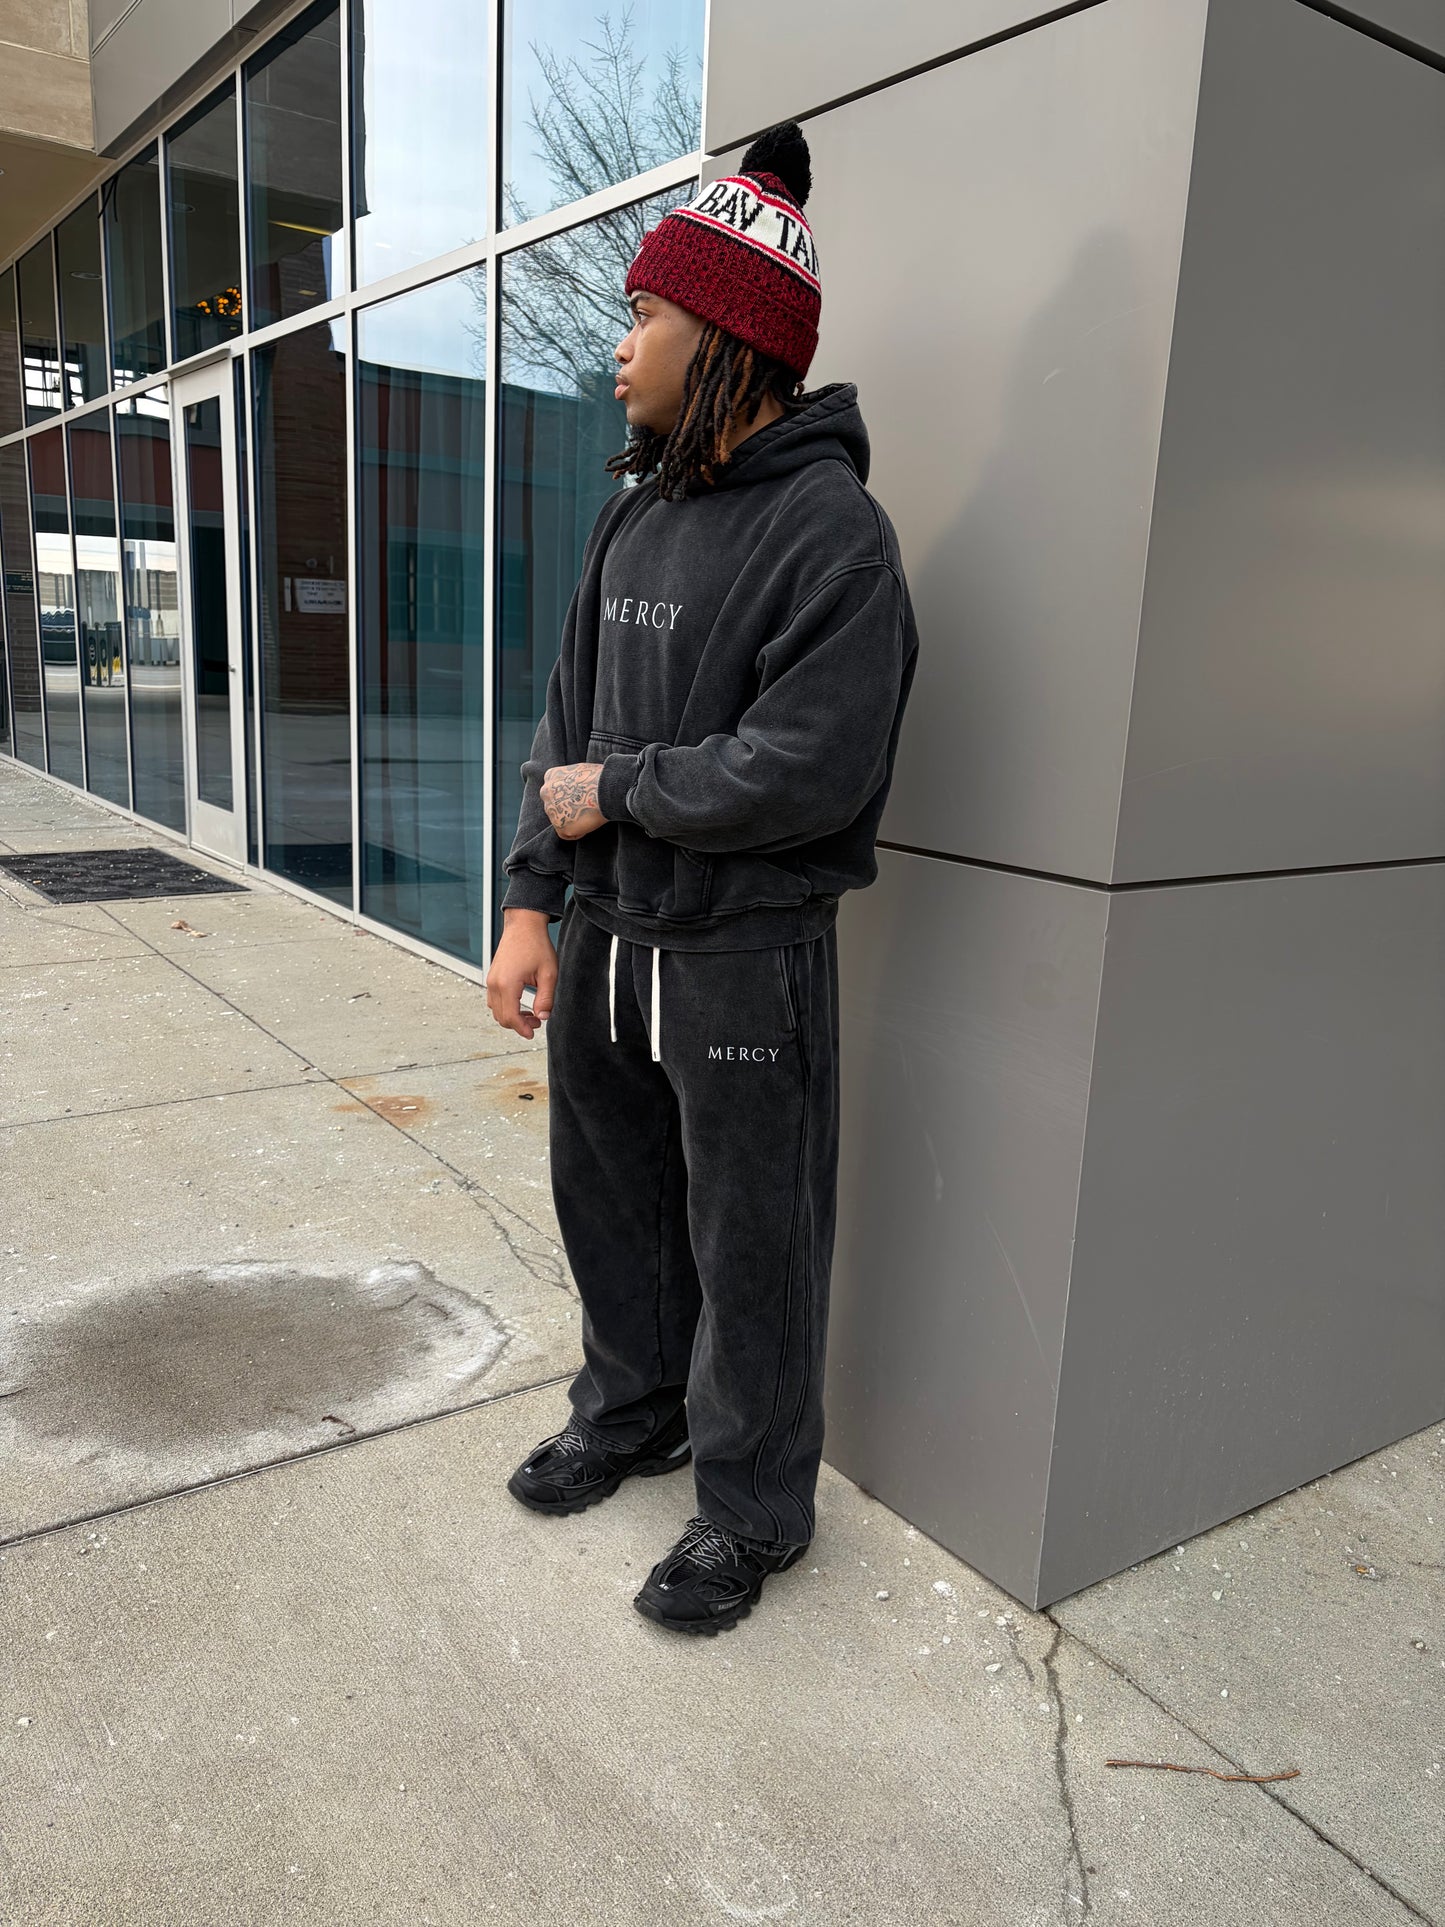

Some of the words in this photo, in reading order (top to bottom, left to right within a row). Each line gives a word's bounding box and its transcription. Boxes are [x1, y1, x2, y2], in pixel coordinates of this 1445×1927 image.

[695, 184, 764, 232] BAY
[603, 597, 683, 630] MERCY
[708, 1045, 780, 1062] MERCY
